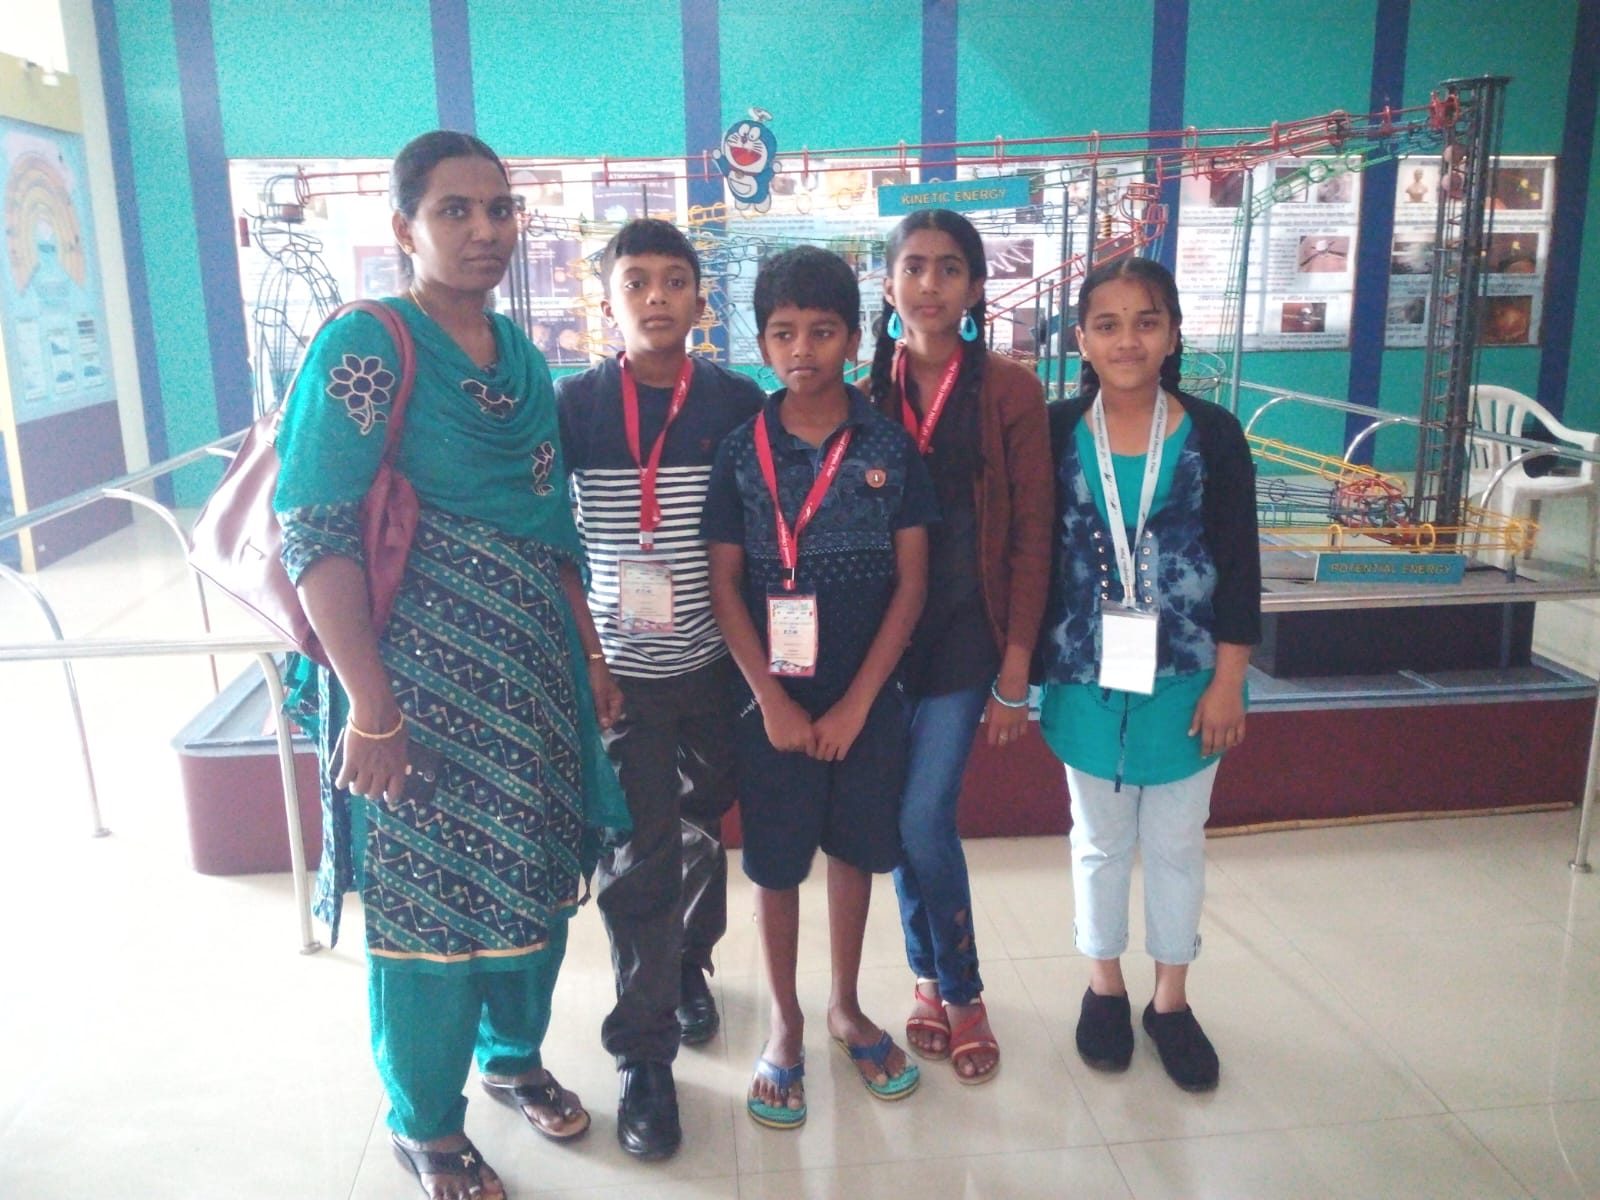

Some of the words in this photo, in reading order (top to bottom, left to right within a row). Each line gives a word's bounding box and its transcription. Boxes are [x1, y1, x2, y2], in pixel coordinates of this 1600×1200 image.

[902, 191, 950, 205] KINETIC
[954, 188, 1007, 202] ENERGY
[1330, 562, 1395, 575] POTENTIAL
[1402, 562, 1451, 576] ENERGY
